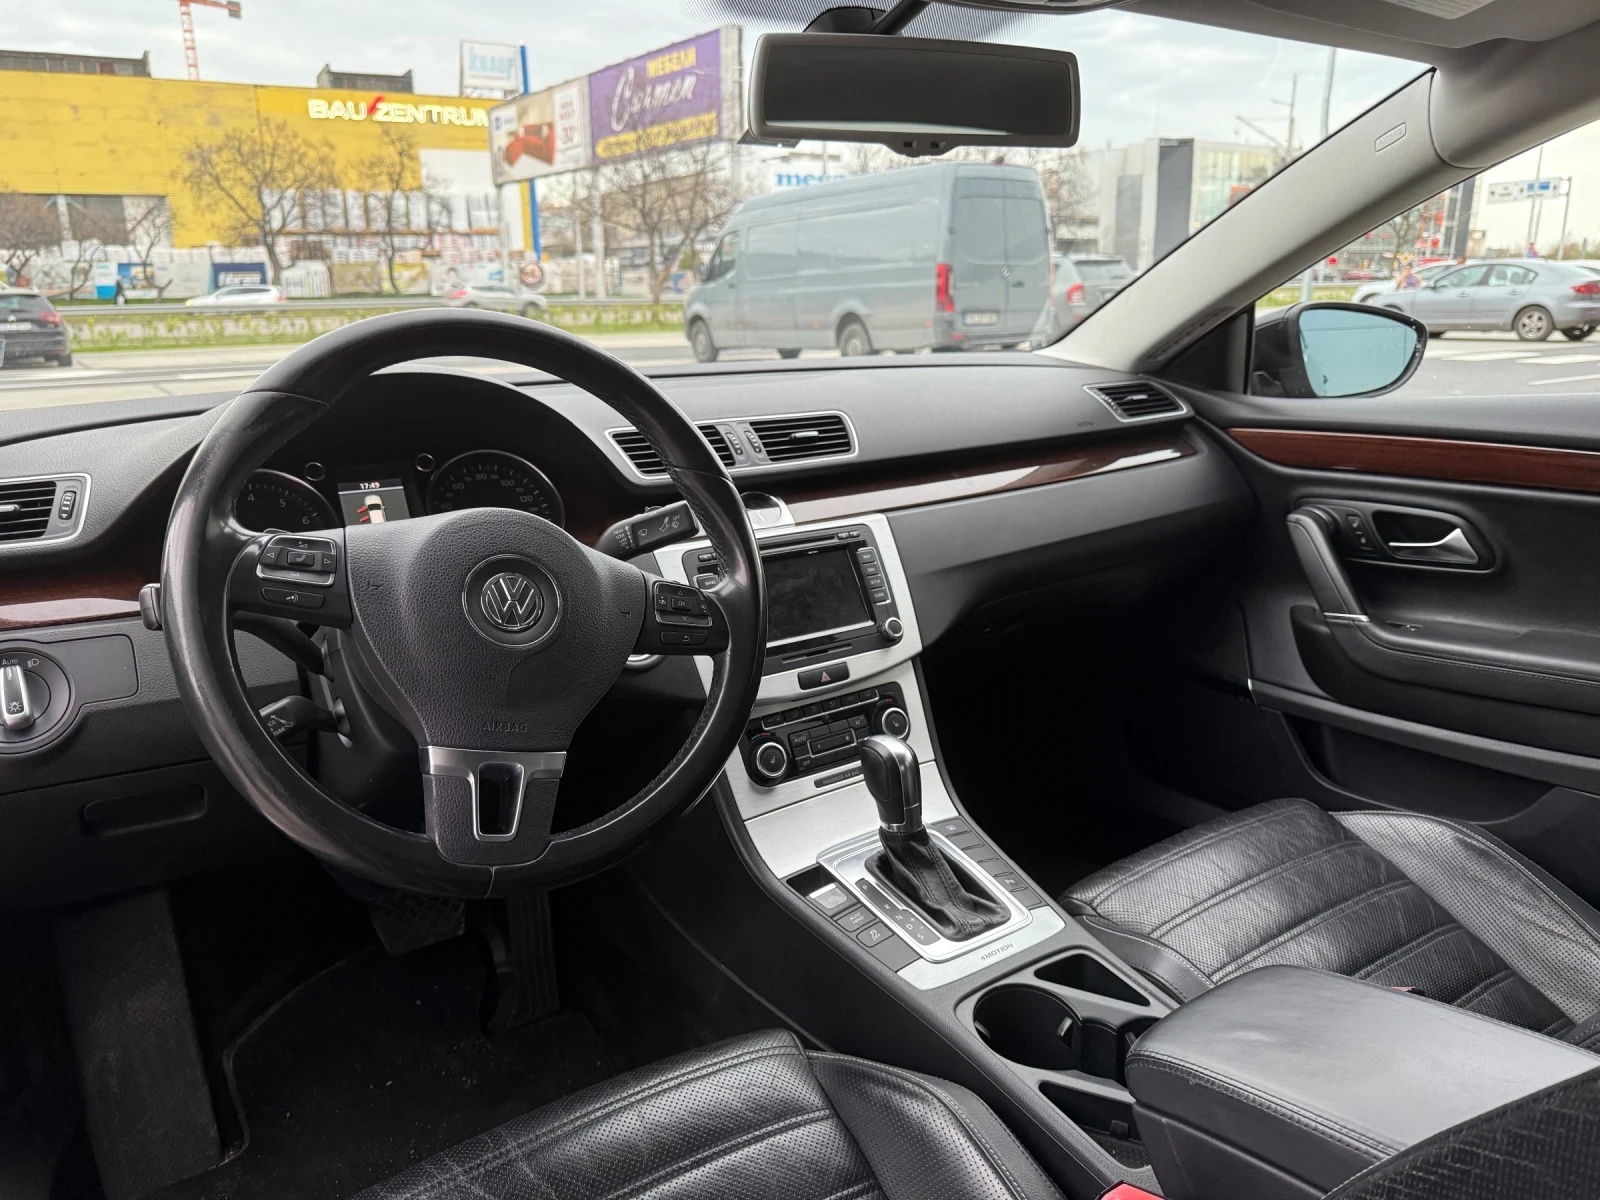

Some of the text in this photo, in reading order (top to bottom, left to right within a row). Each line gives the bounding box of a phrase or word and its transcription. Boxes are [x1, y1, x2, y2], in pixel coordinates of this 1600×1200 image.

[611, 66, 697, 132] Carmen
[307, 99, 368, 121] BAU
[475, 473, 488, 481] 80
[360, 481, 380, 490] 17:49
[452, 482, 464, 490] 60
[500, 479, 515, 487] 100
[248, 493, 255, 502] 4
[519, 495, 533, 503] 120
[279, 499, 286, 508] 5
[440, 502, 452, 510] 40
[302, 516, 310, 525] 6
[483, 721, 528, 733] AIRBAG
[794, 735, 807, 743] AUTO
[822, 774, 845, 785] PASSENGER
[980, 942, 1014, 961] 4MOTION
